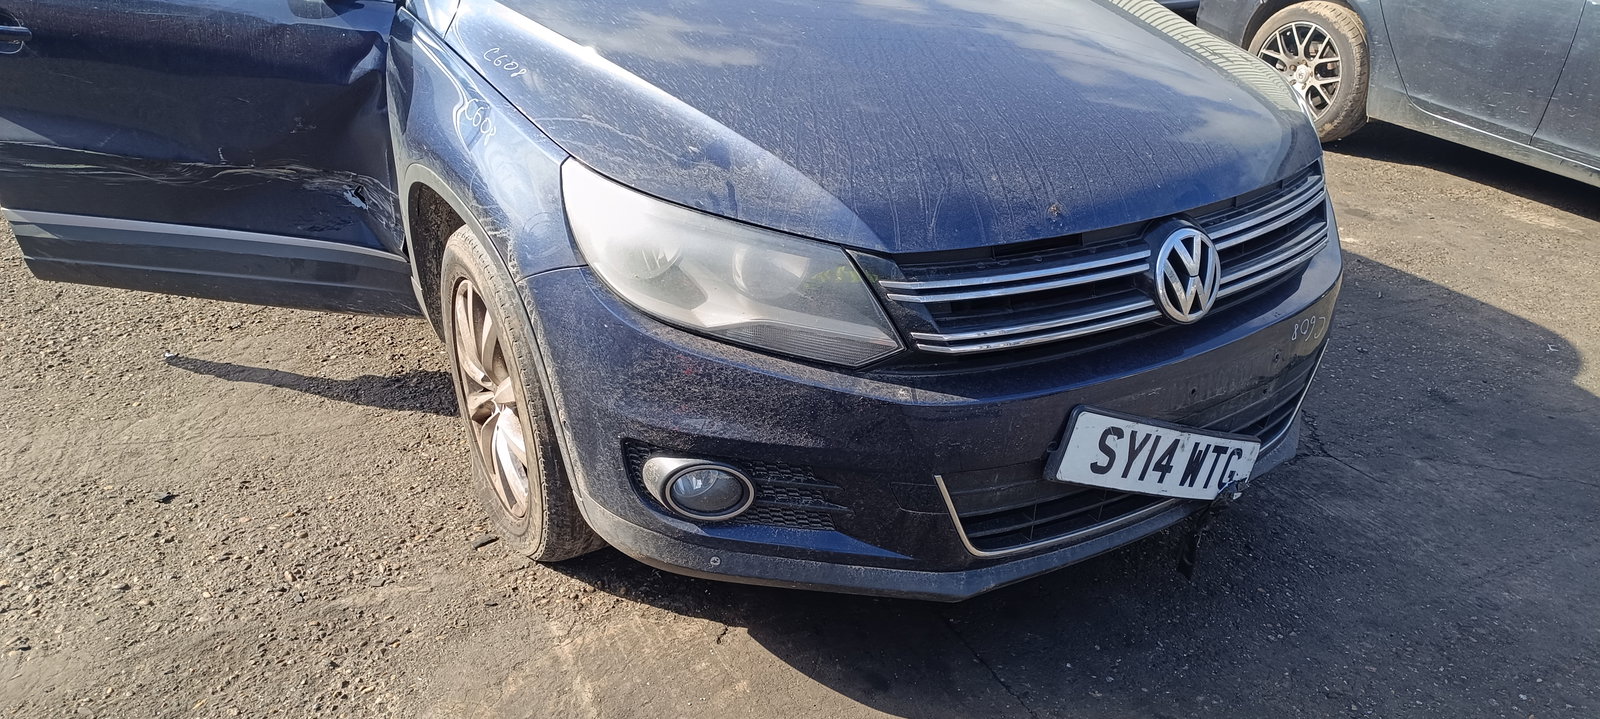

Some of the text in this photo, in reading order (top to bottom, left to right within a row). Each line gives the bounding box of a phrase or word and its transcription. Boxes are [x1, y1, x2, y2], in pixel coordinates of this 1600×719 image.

[484, 47, 527, 77] C608
[1156, 227, 1221, 323] VW
[1090, 426, 1243, 490] SY14 WTG
